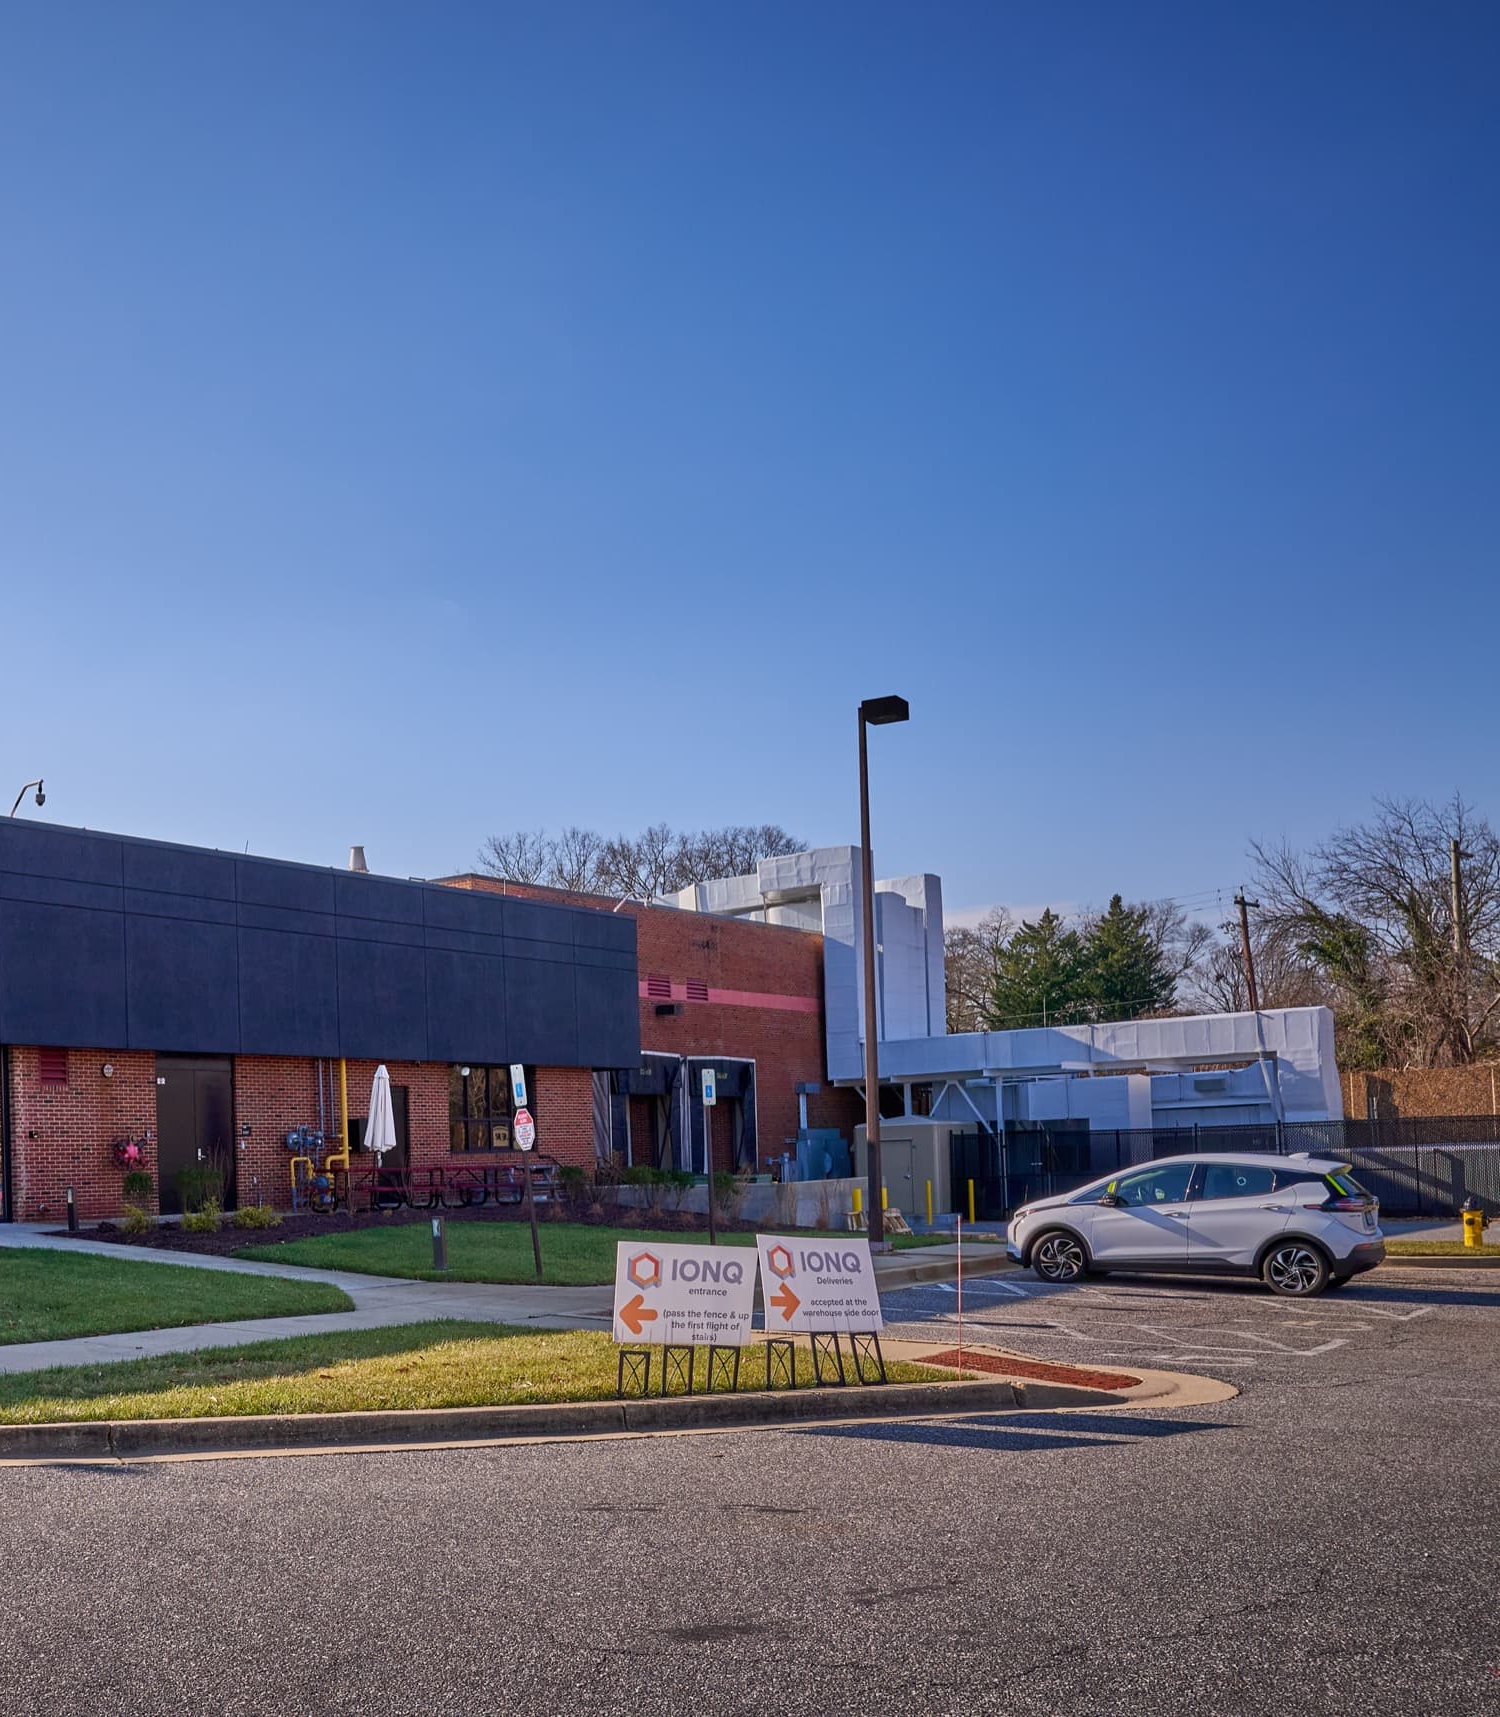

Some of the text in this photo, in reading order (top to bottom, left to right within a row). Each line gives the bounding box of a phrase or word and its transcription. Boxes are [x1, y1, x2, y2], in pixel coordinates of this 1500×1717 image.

[800, 1251, 861, 1273] IONQ
[671, 1259, 743, 1285] IONQ
[817, 1277, 853, 1285] Deliveries
[689, 1288, 727, 1296] entrance
[810, 1299, 844, 1307] accepted
[663, 1309, 749, 1320] (pass the fence & up
[671, 1321, 685, 1329] the
[687, 1321, 704, 1329] first
[706, 1322, 728, 1331] flight
[692, 1333, 717, 1342] stairs)
